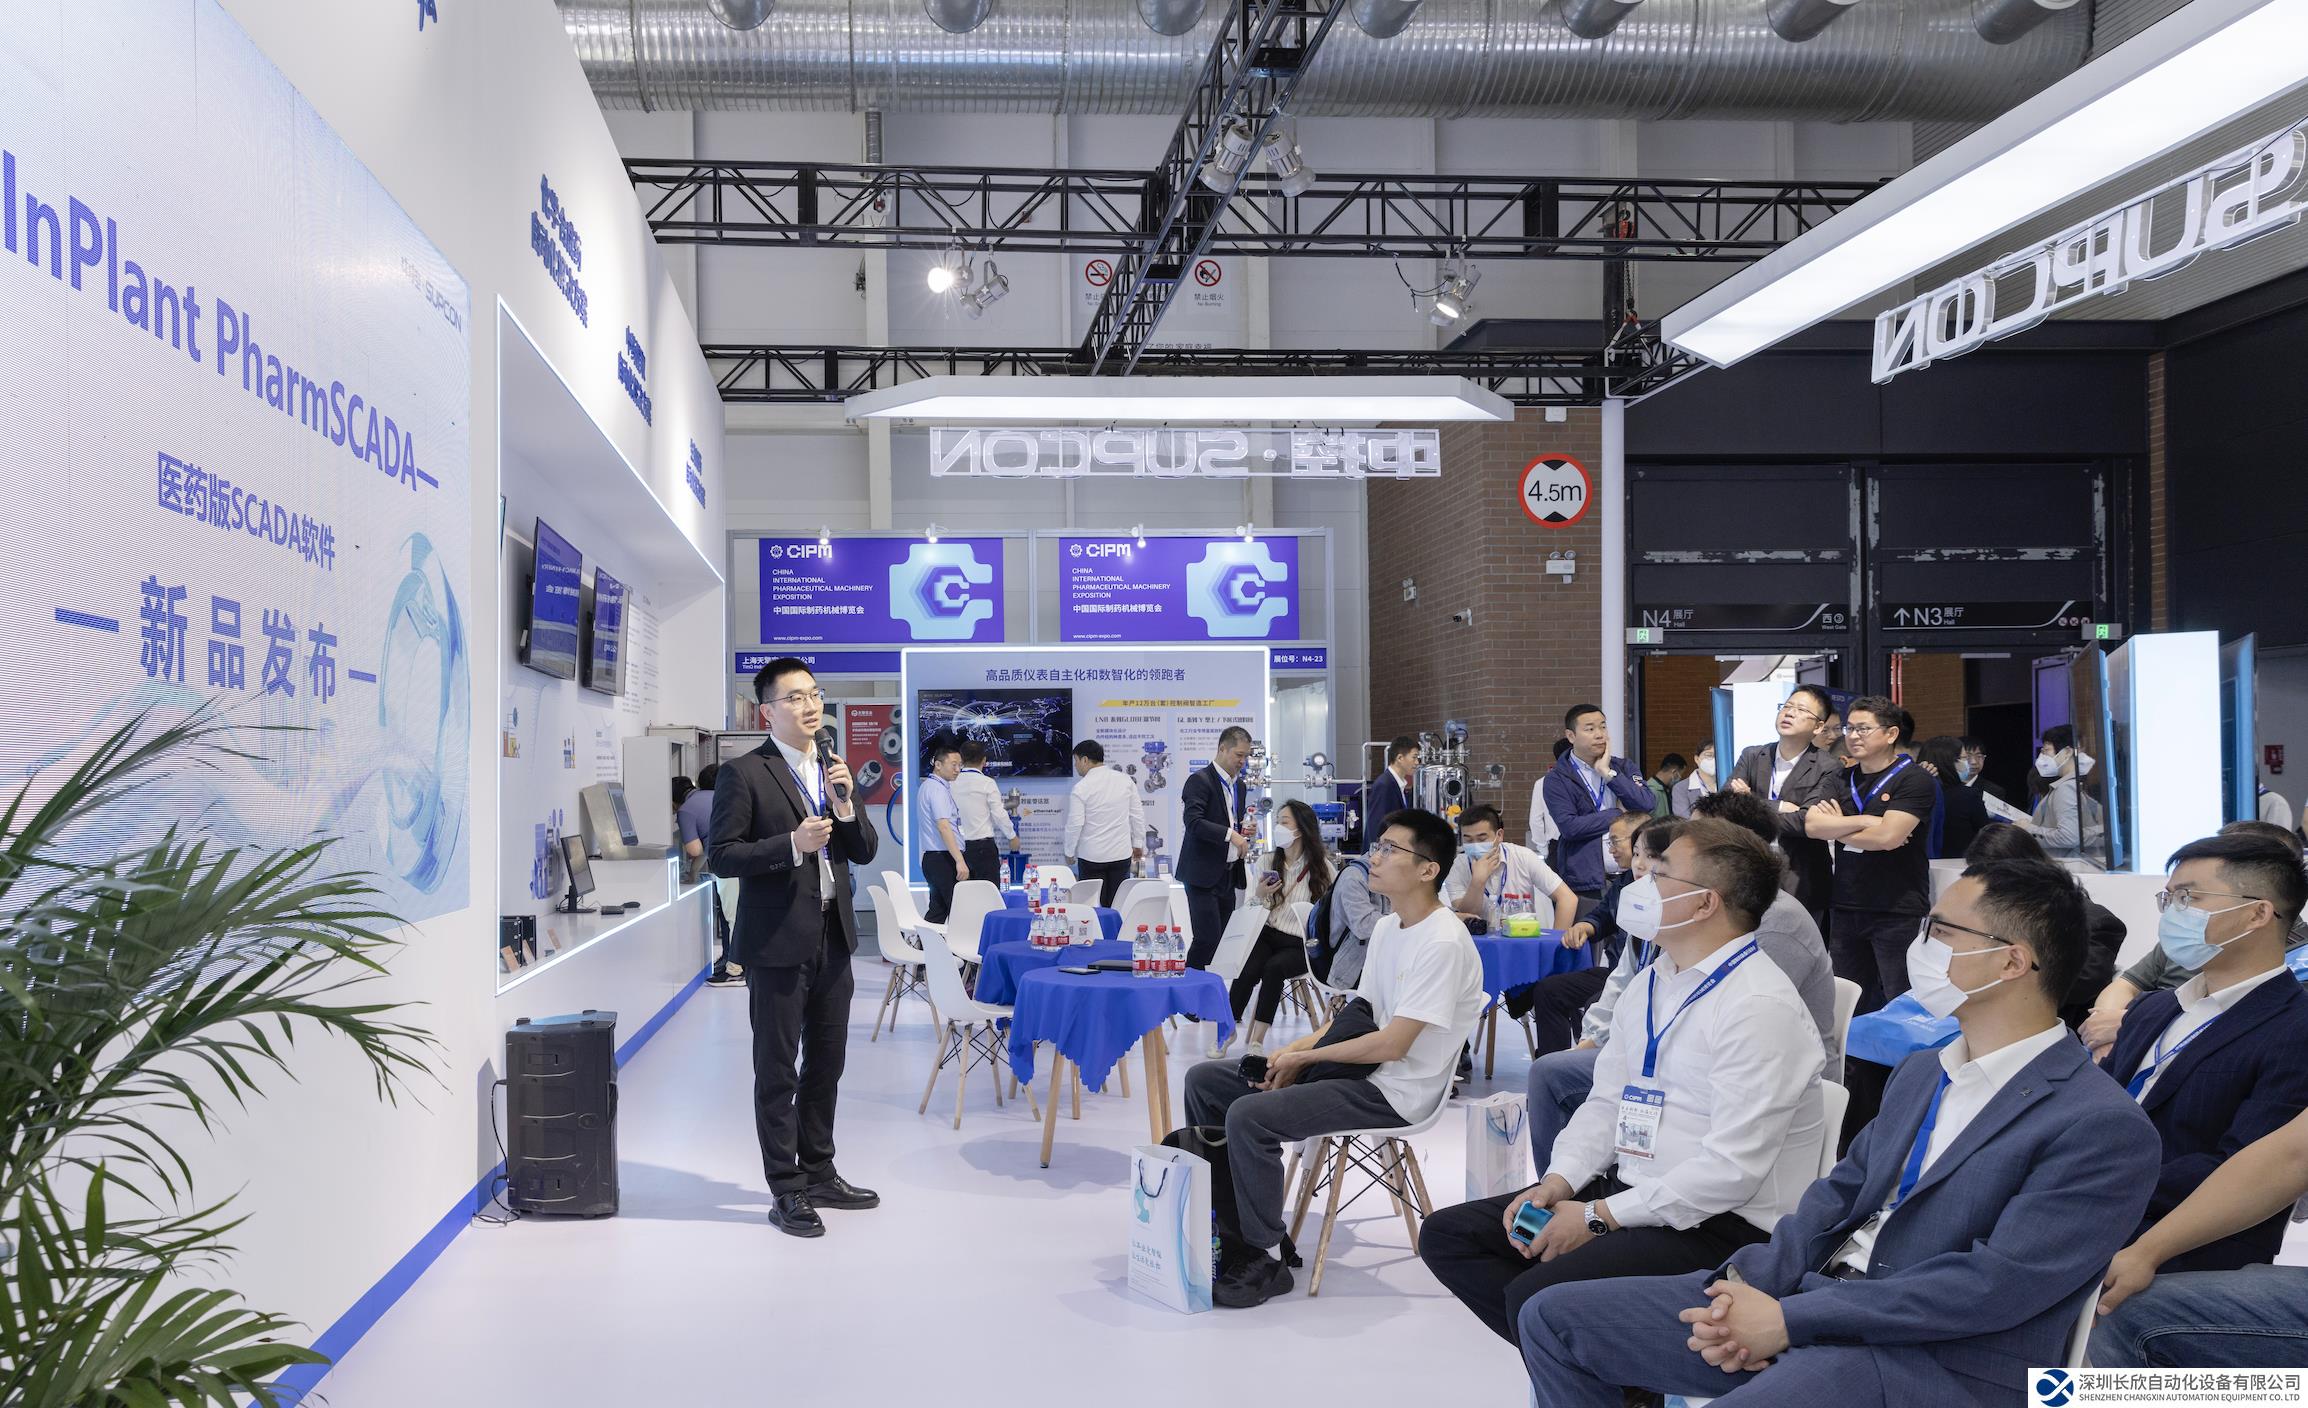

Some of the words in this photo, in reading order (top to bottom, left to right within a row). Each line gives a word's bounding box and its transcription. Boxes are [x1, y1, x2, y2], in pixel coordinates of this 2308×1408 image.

[3, 150, 201, 363] InPlant
[425, 280, 462, 333] SUPCON
[1528, 480, 1582, 501] 4.5m
[157, 451, 336, 571] 医药版SCADA软件
[786, 544, 833, 559] CIPM
[1085, 543, 1131, 558] CIPM
[772, 568, 794, 576] CHINA
[772, 576, 825, 584] INTERNATIONAL
[833, 584, 874, 592] MACHINERY
[1072, 583, 1132, 591] PHARMACEUTICAL
[772, 593, 813, 601] EXPOSITION
[1072, 591, 1112, 599] EXPOSITION
[773, 606, 865, 615] 中国国际制药机械博览会
[1072, 604, 1163, 613] 中国国际制药机械博览会
[1643, 610, 1672, 628] N4
[1673, 609, 1694, 620] 展厅
[1914, 607, 1943, 626] N3
[1943, 607, 1964, 618] 展厅
[140, 575, 338, 704] 新品发布
[773, 634, 823, 642] www.cipm-expo.com
[1072, 632, 1122, 640] www.cipm-expo.com
[1302, 655, 1324, 663] N4-23
[985, 668, 1186, 682] 高品质仪表自主化和数智化的领跑者
